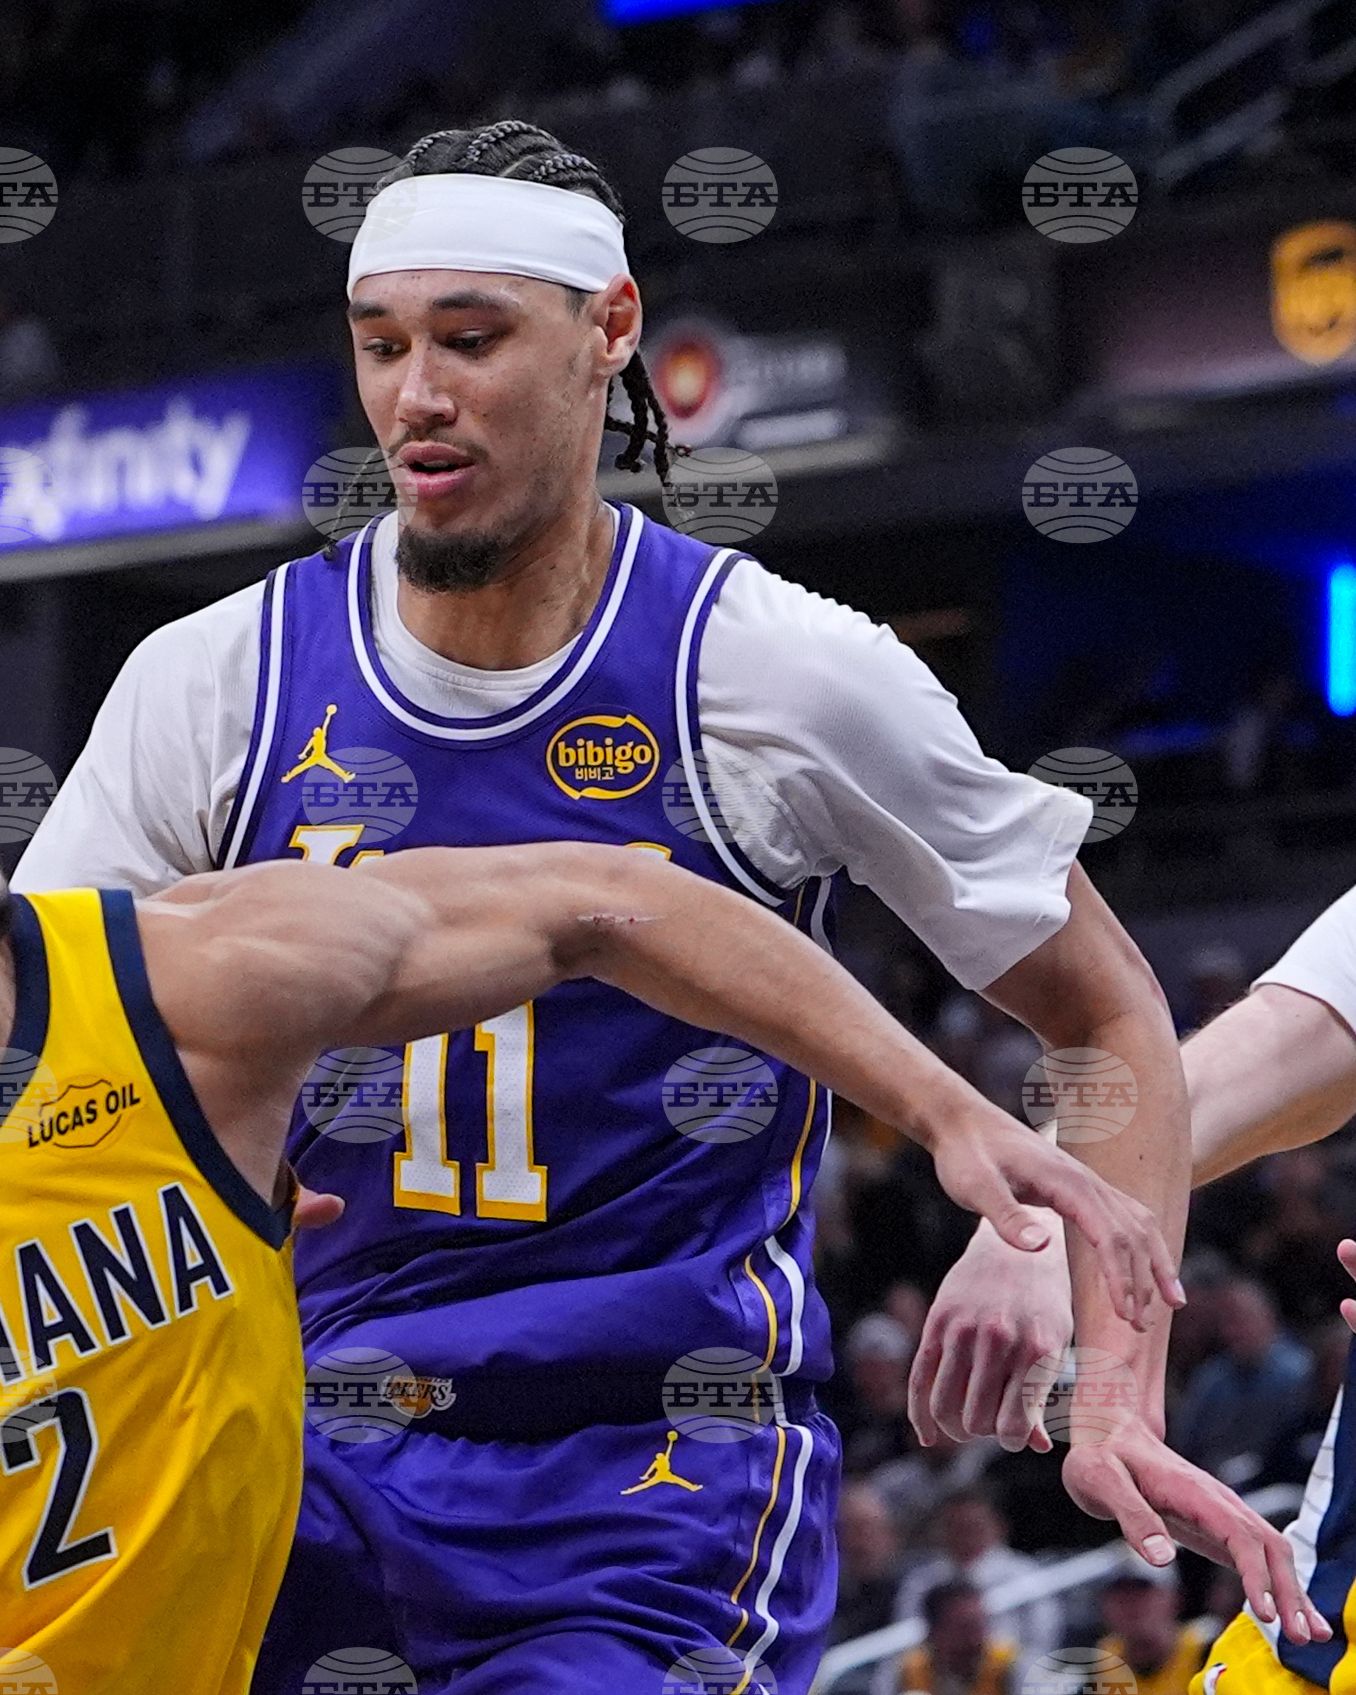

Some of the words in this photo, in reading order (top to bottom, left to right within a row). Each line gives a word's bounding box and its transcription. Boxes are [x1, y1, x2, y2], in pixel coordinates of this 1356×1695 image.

[557, 737, 653, 774] bibigo
[575, 767, 615, 781] 비비고
[27, 1099, 97, 1149] LUCAS
[105, 1083, 141, 1114] OIL
[393, 999, 548, 1222] 11
[0, 1386, 119, 1591] 2
